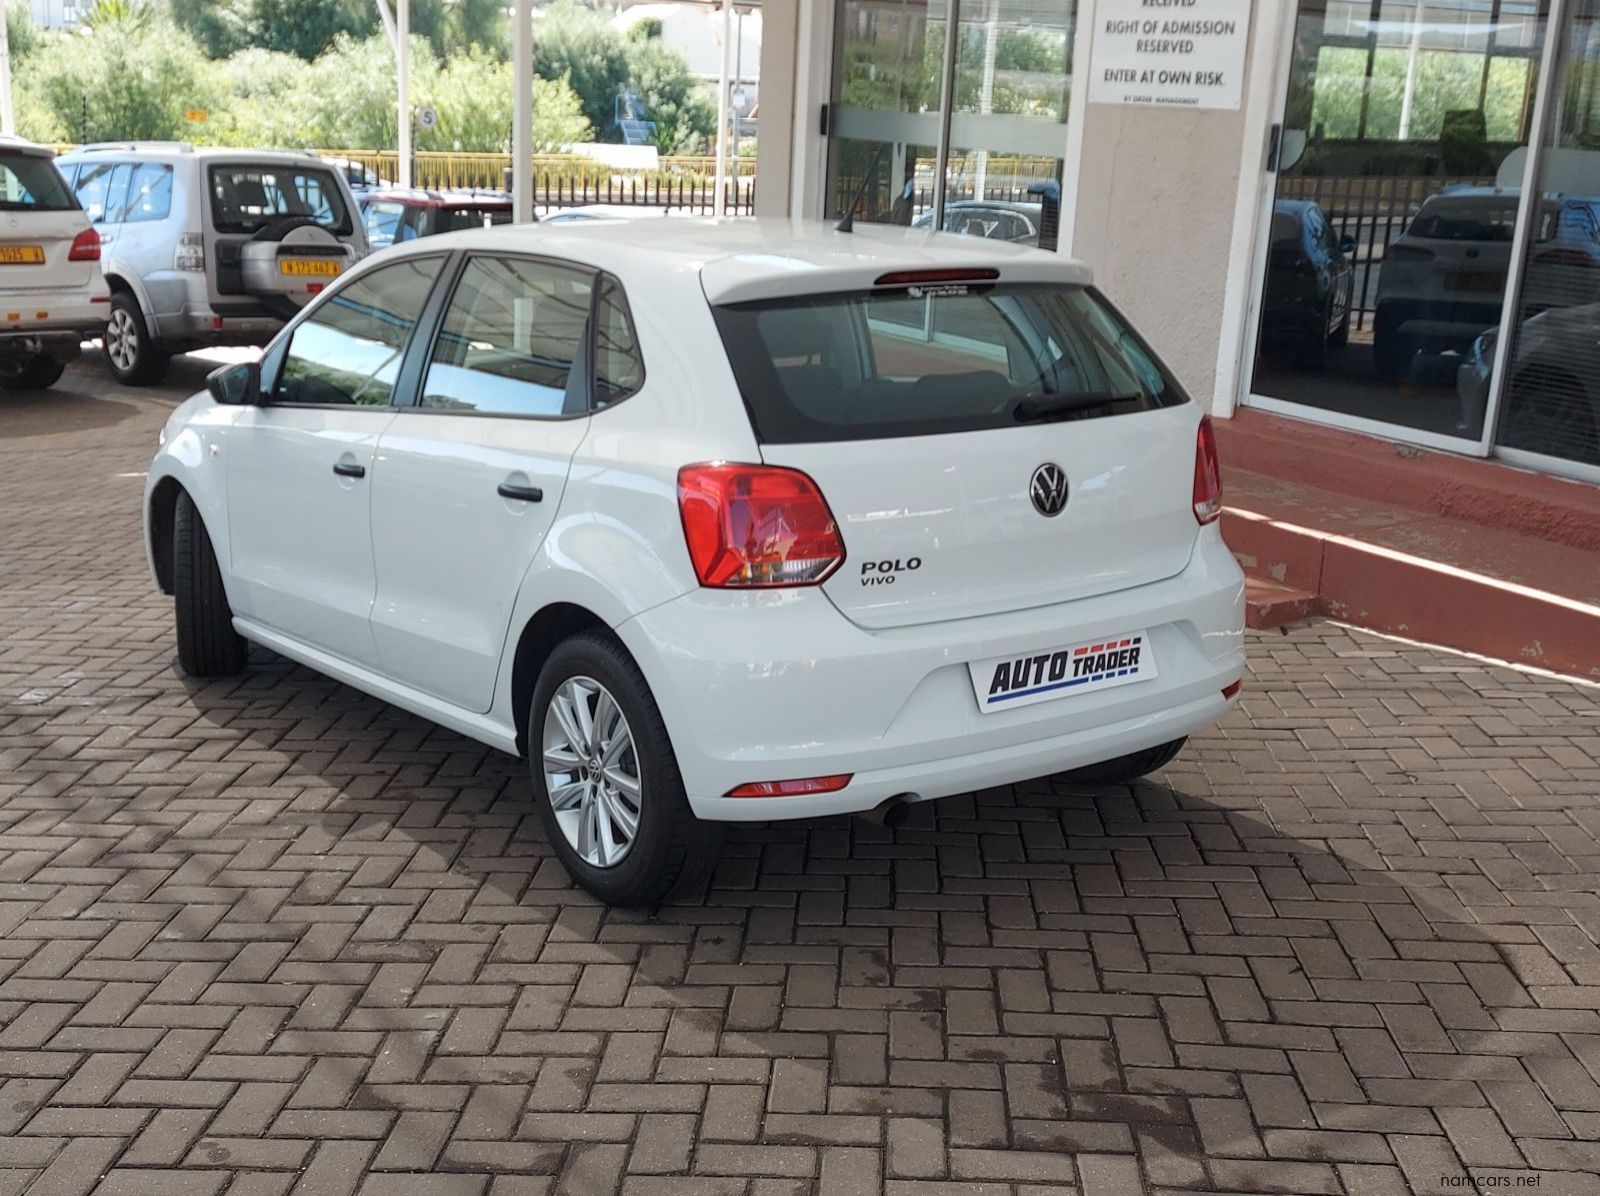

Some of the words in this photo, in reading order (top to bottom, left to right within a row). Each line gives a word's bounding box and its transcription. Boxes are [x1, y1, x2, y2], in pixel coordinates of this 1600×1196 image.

[1106, 20, 1139, 34] RIGHT
[1143, 20, 1158, 34] OF
[1162, 21, 1235, 35] ADMISSION
[1136, 39, 1193, 53] RESERVED
[1104, 69, 1137, 82] ENTER
[1140, 71, 1154, 83] AT
[1158, 71, 1191, 85] OWN
[861, 557, 922, 575] POLO
[861, 575, 896, 586] VIVO
[989, 650, 1068, 695] AUTO
[1073, 647, 1140, 677] TRADER
